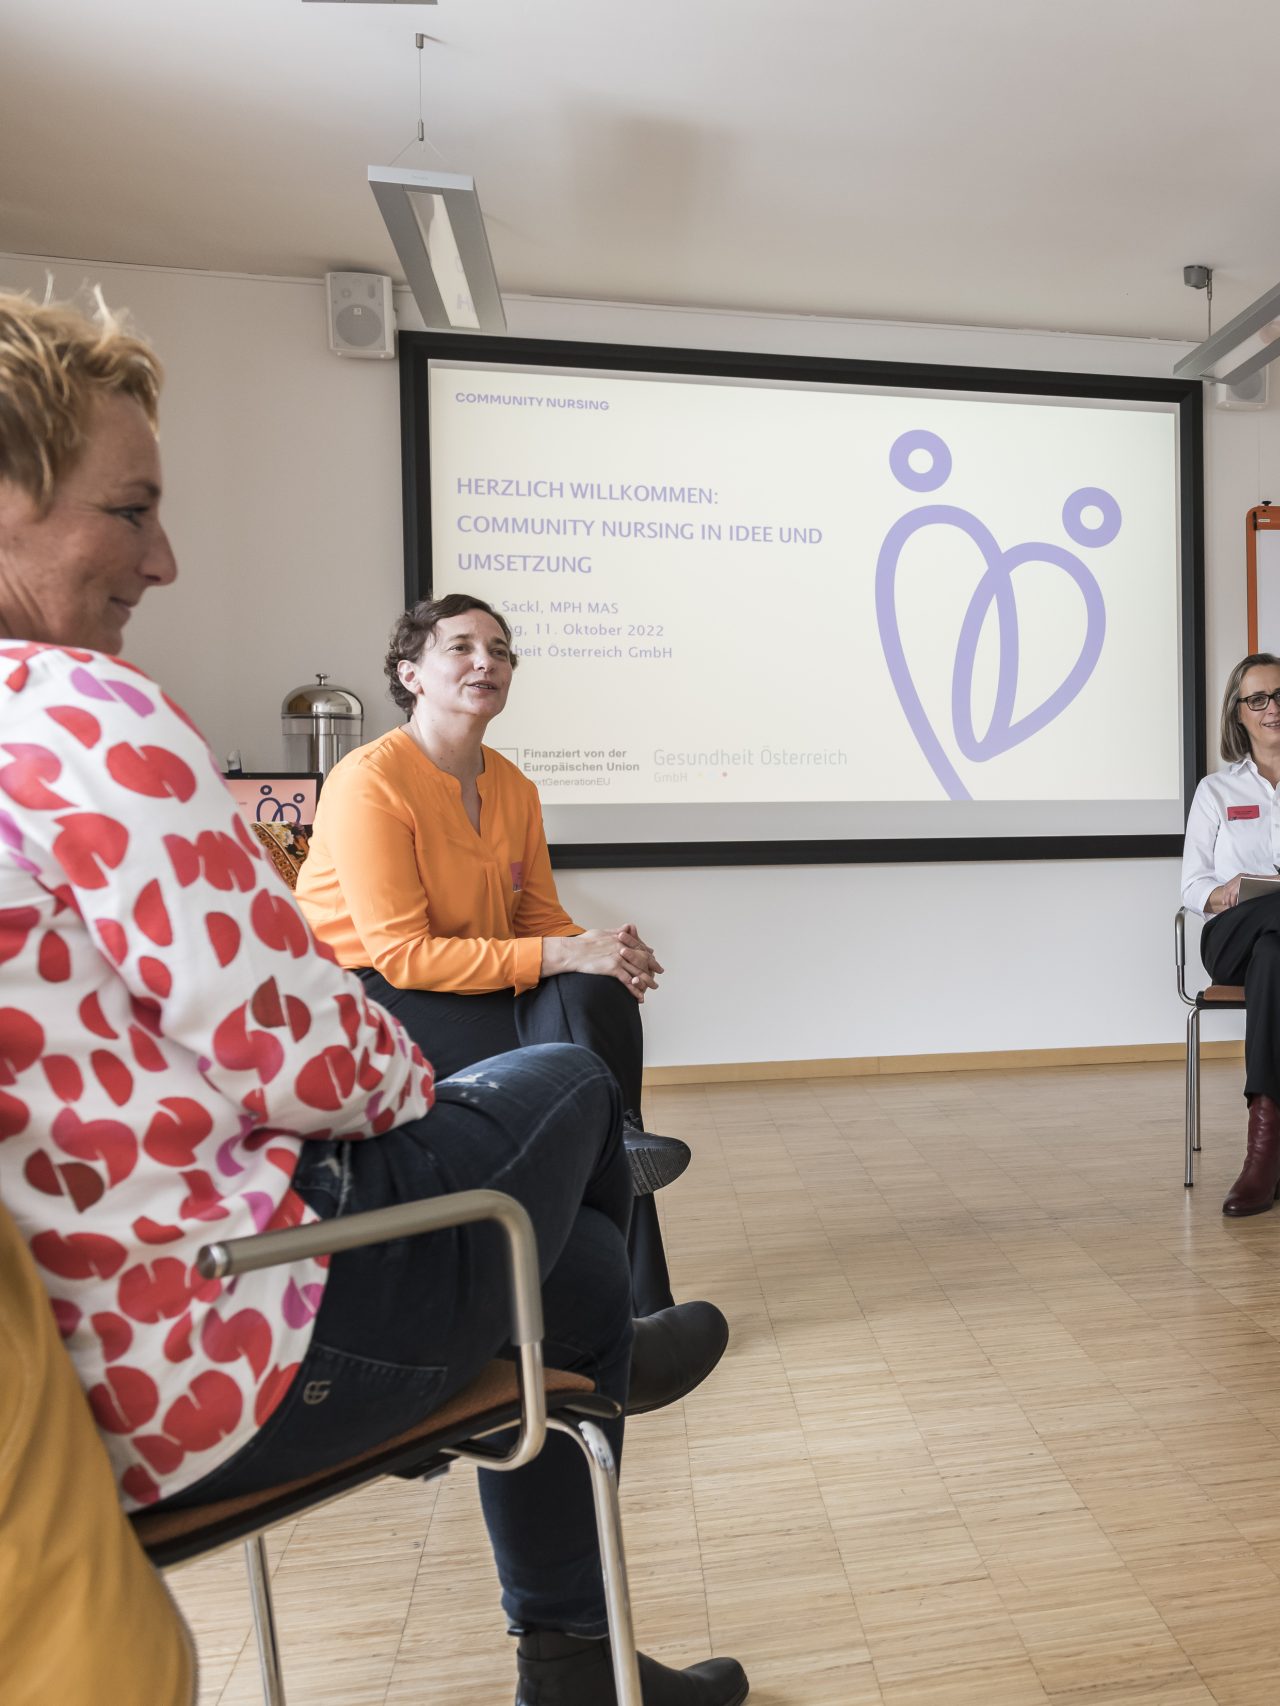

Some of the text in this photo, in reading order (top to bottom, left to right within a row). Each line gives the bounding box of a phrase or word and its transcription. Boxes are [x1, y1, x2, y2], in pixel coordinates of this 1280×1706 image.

[455, 392, 610, 411] COMMUNITY NURSING
[456, 477, 718, 505] HERZLICH WILLKOMMEN:
[456, 514, 823, 545] COMMUNITY NURSING IN IDEE UND
[457, 552, 592, 574] UMSETZUNG
[502, 600, 544, 614] Sackl,
[550, 601, 582, 614] MPH
[587, 602, 619, 615] MAS
[535, 622, 558, 635] 11.
[563, 623, 623, 636] Oktober
[627, 624, 664, 637] 2022
[548, 643, 623, 658] Österreich
[628, 646, 673, 659] GmbH
[523, 748, 628, 759] Finanziert von der
[653, 745, 848, 766] Gesundheit Österreich
[523, 761, 640, 774] Europäischen Union
[653, 771, 688, 783] GmbH
